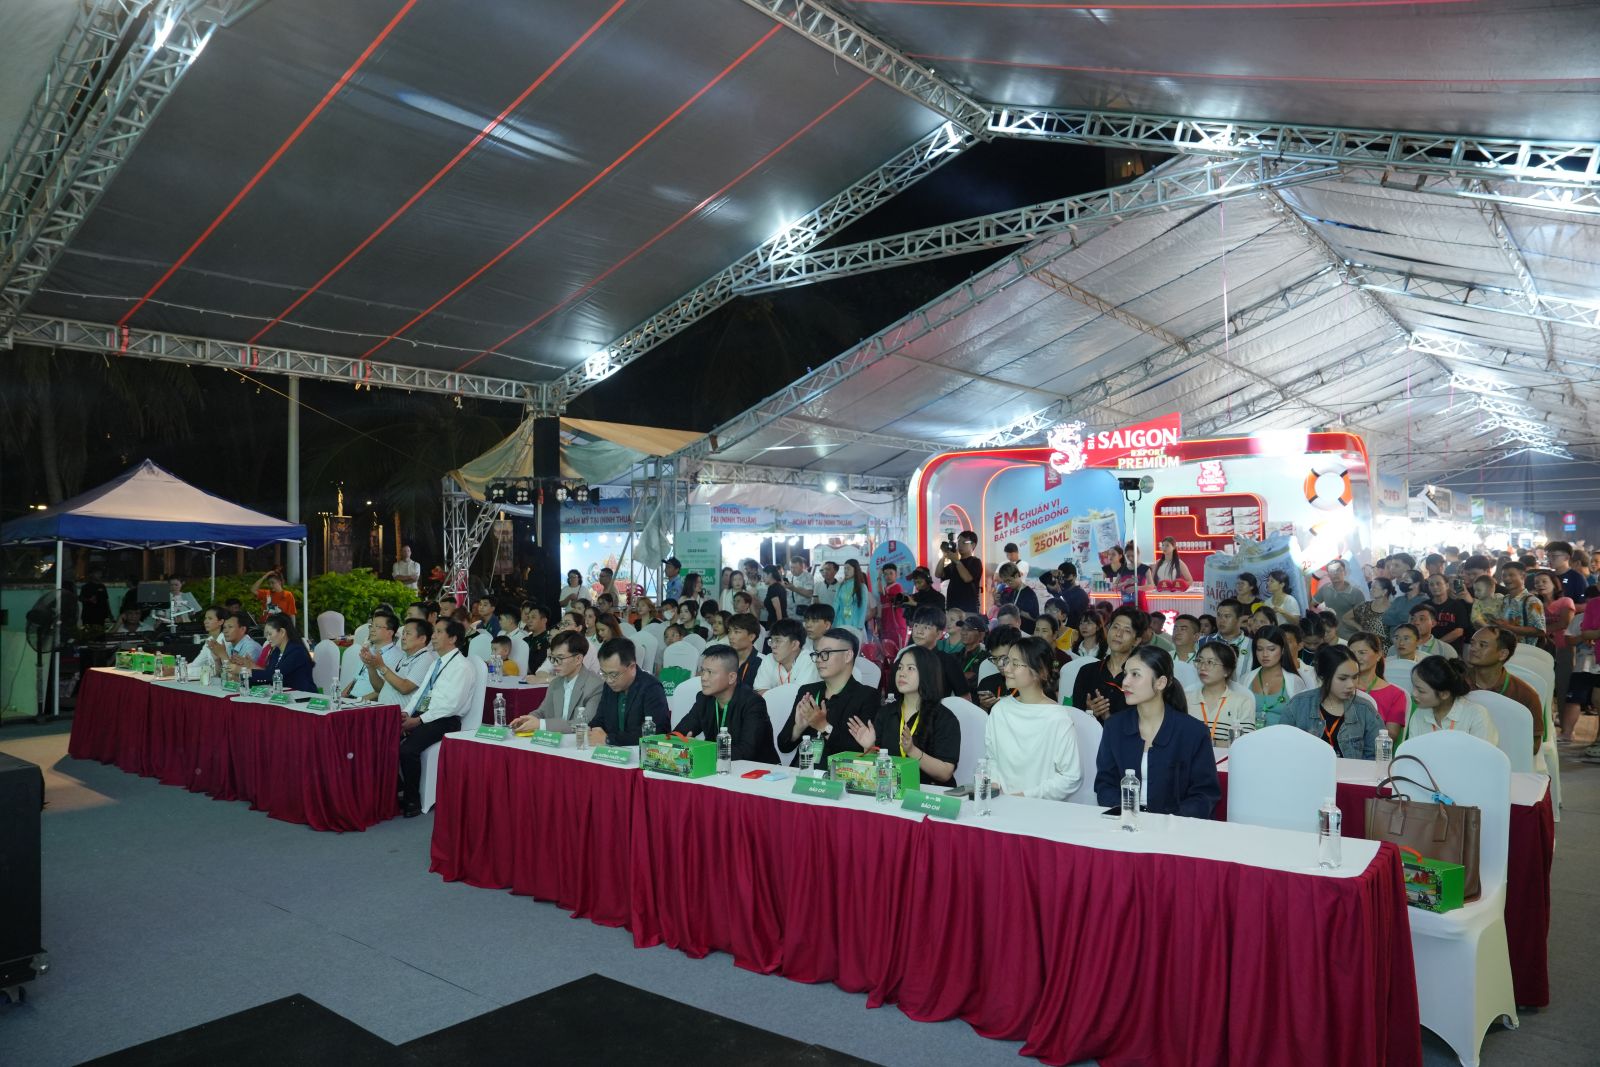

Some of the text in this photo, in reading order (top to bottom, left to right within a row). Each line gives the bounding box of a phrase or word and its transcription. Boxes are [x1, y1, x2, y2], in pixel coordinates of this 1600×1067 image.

[1087, 427, 1178, 450] BIA SAIGON
[1117, 455, 1180, 469] PREMIUM
[993, 507, 1019, 532] ÊM
[1034, 531, 1070, 553] 250ML
[1216, 581, 1228, 590] BIA
[662, 680, 676, 688] Grab
